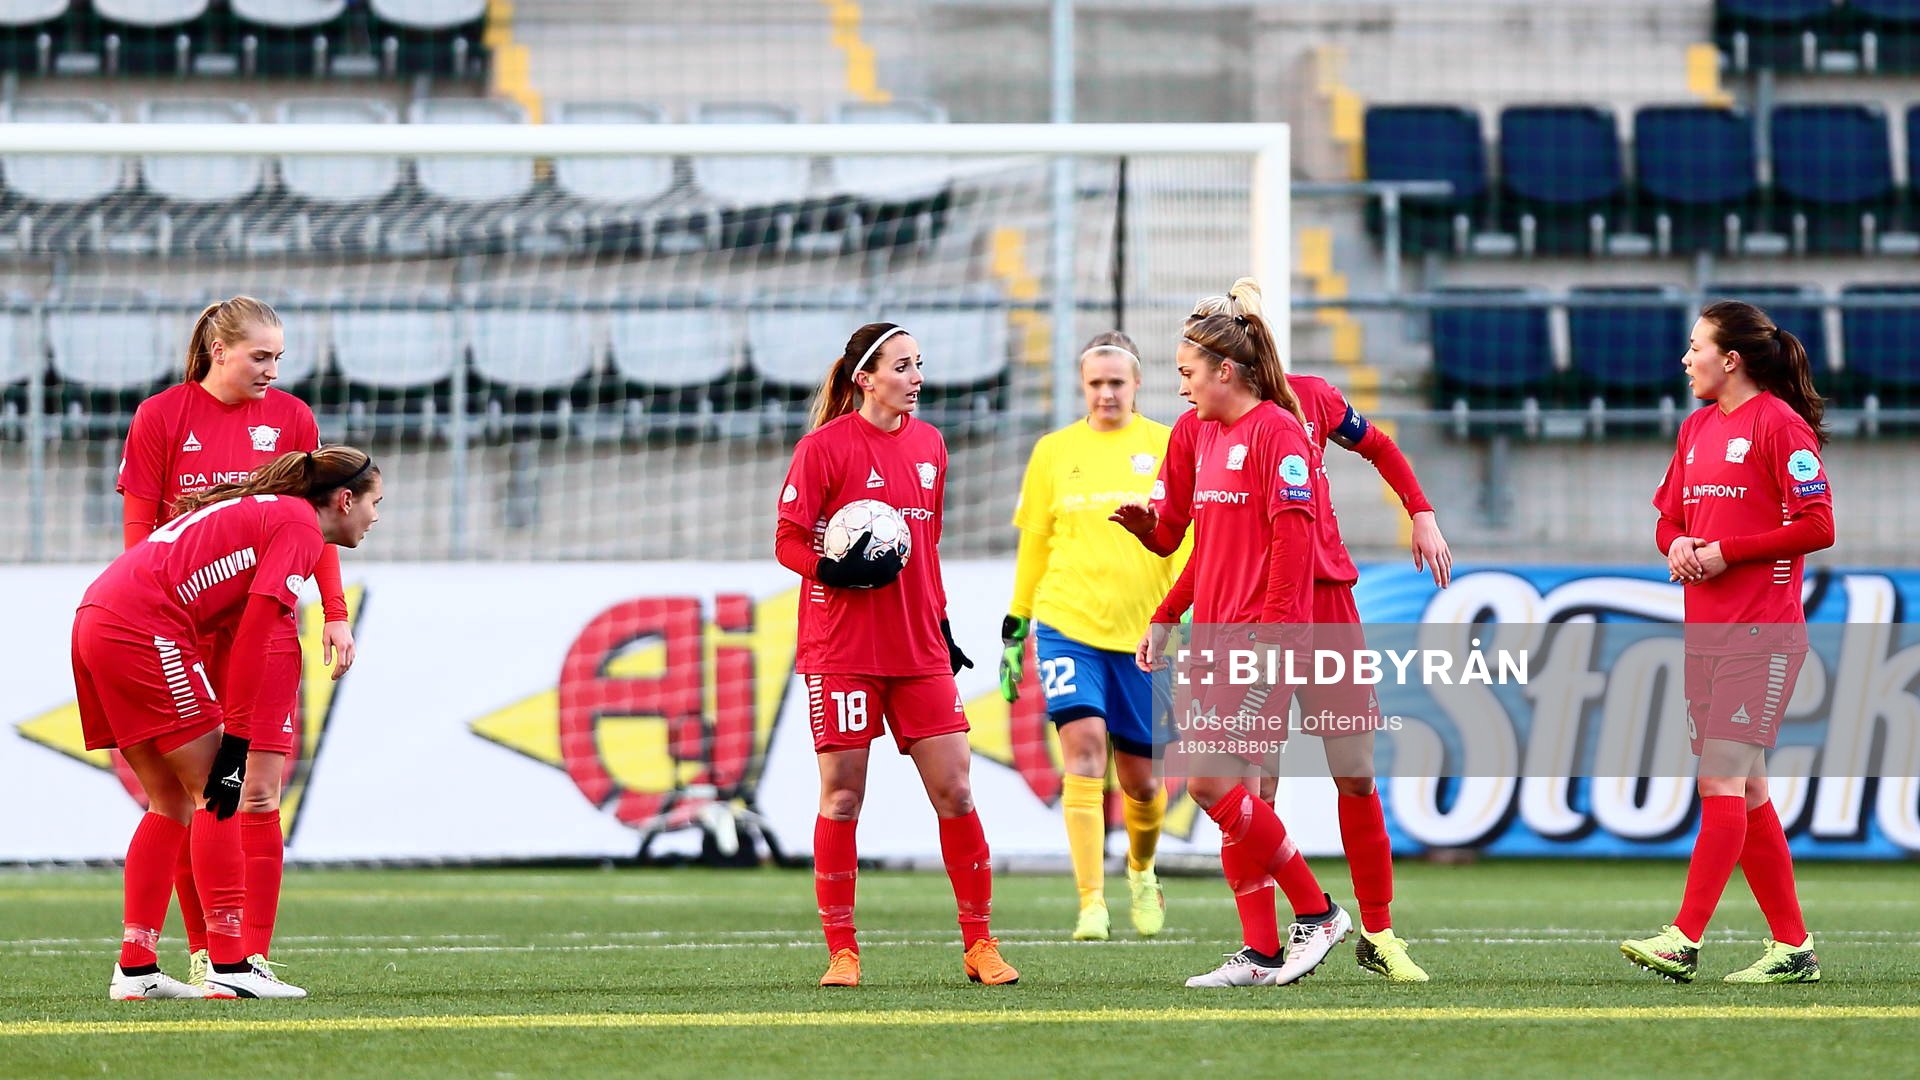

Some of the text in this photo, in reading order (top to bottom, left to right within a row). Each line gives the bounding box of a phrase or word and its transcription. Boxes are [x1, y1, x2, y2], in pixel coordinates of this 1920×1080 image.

[179, 473, 208, 486] IDA
[1196, 490, 1250, 505] INFRONT
[1693, 484, 1748, 499] INFRONT
[1041, 656, 1077, 699] 22
[830, 690, 867, 733] 18
